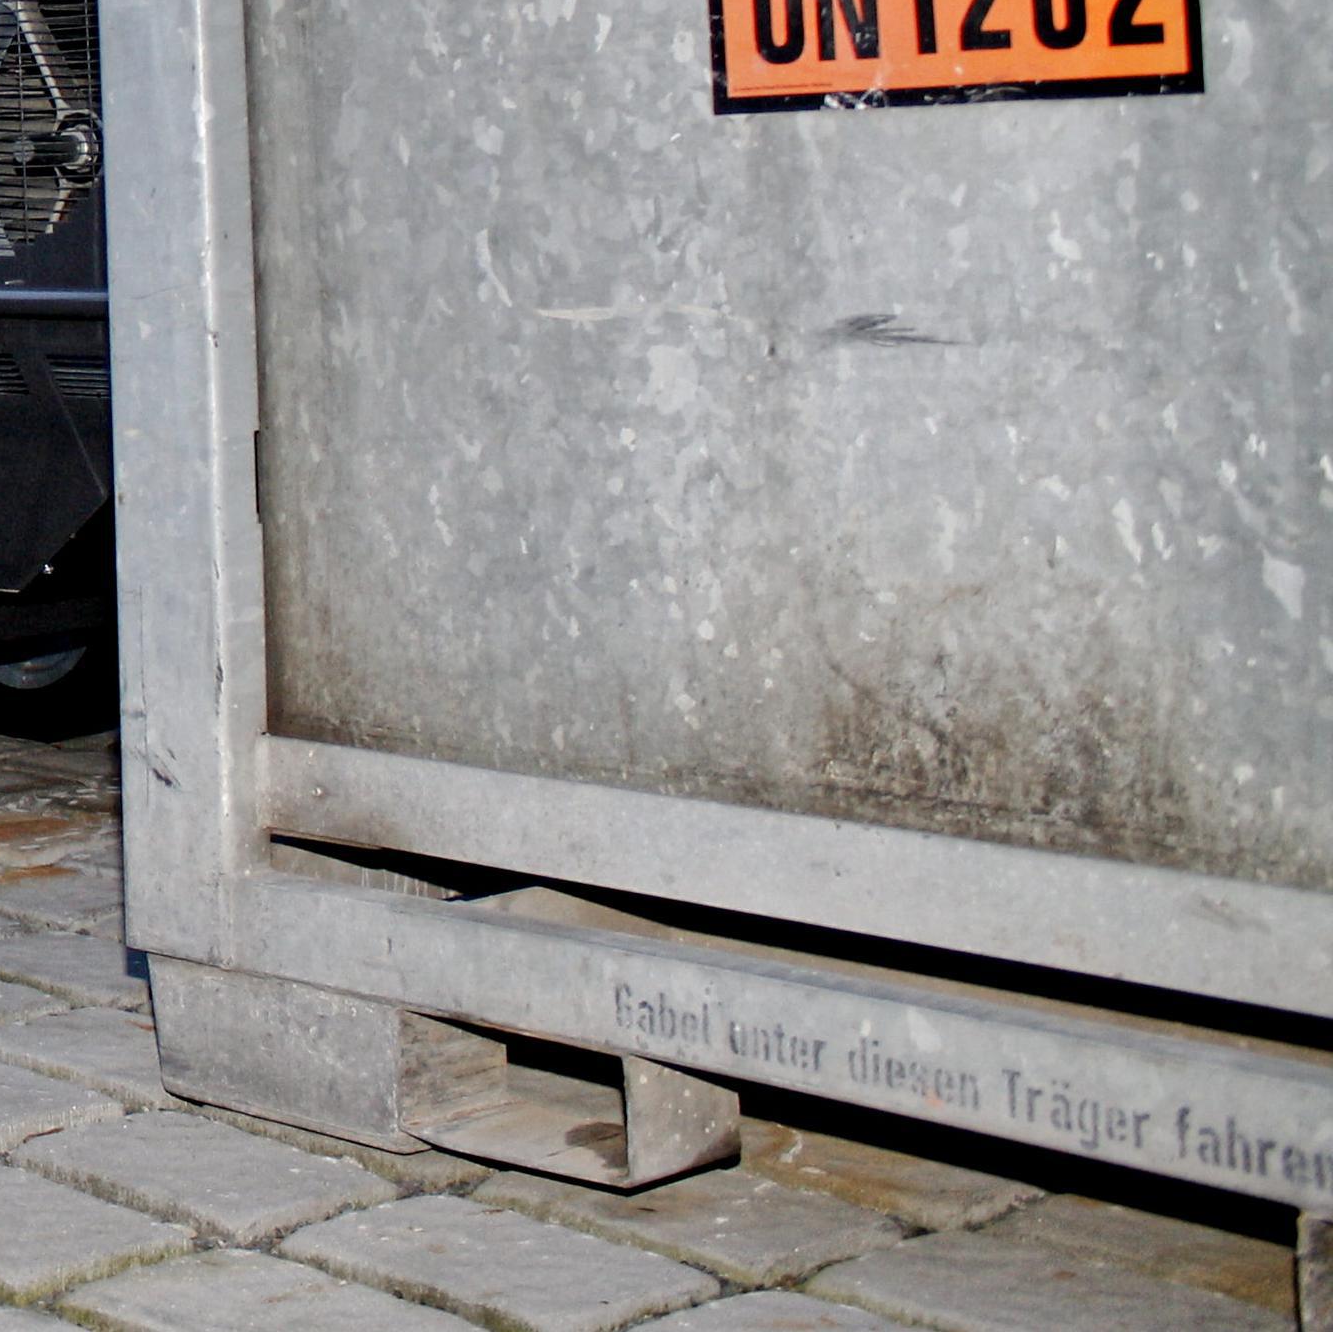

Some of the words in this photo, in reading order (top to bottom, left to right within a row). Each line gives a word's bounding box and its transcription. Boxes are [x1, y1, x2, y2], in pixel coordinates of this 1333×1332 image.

[614, 982, 712, 1047] Gabel
[728, 1020, 828, 1071] unter
[847, 1036, 980, 1111] diesen
[1002, 1068, 1150, 1150] Träger
